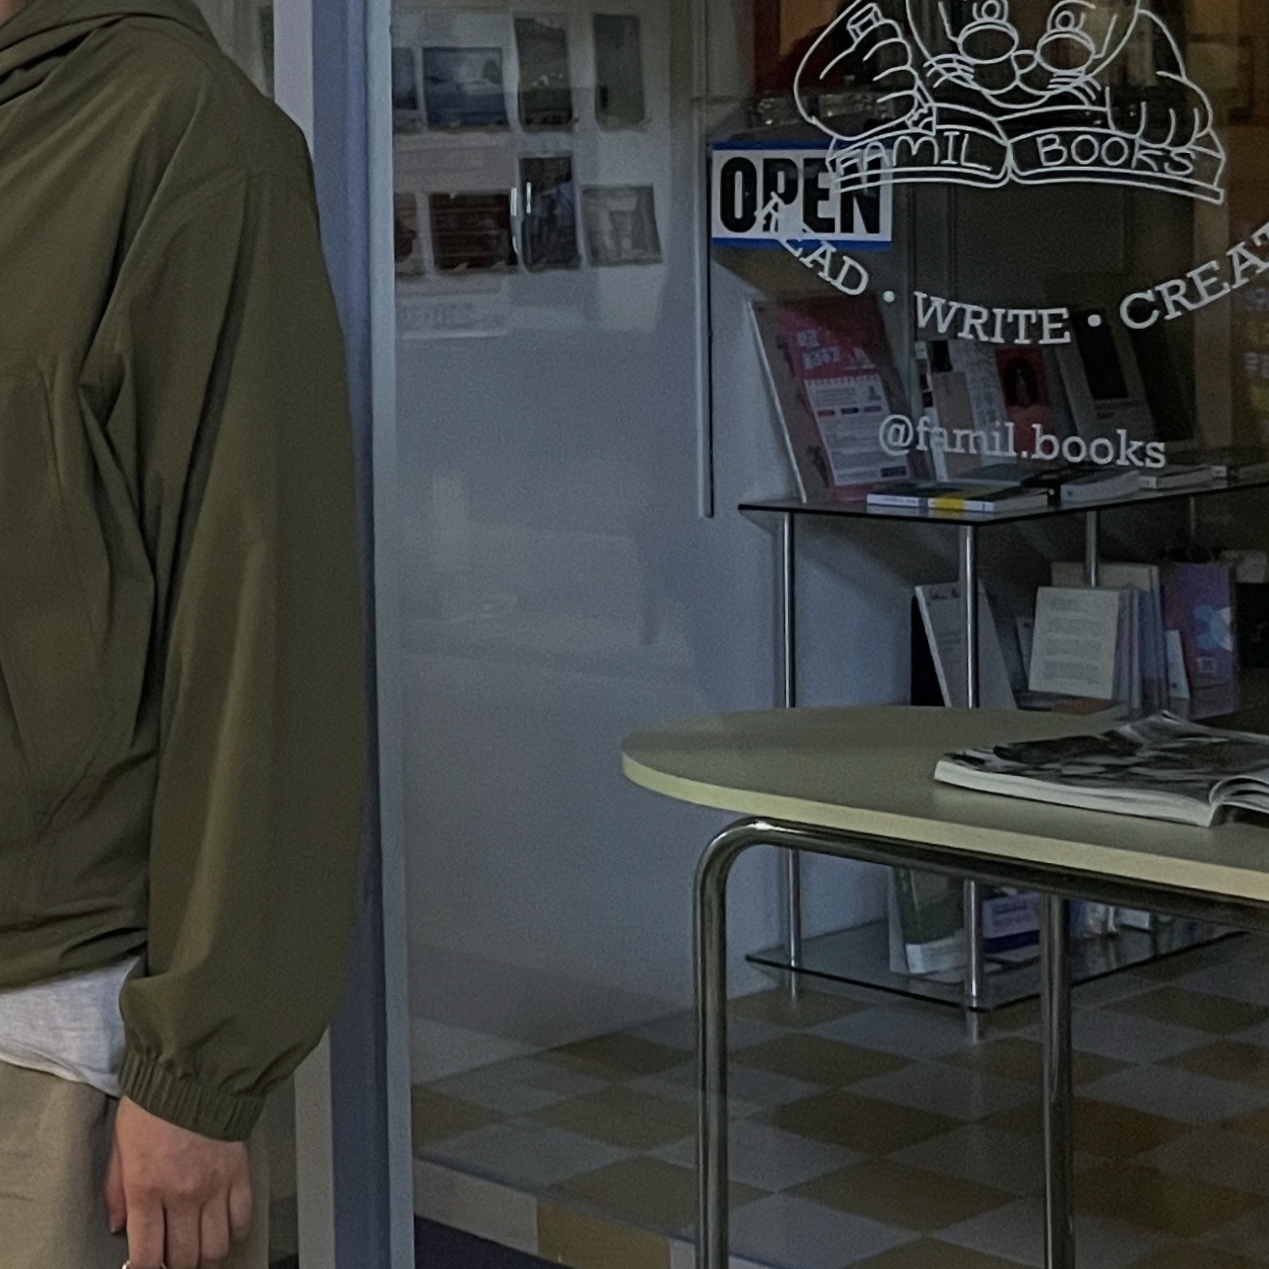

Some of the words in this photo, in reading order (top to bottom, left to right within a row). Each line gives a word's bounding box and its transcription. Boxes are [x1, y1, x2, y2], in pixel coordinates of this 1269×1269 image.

[835, 131, 992, 175] FAMIL
[1037, 133, 1195, 175] BOOKS
[720, 156, 882, 233] OPEN
[914, 291, 1071, 344] WRITE
[878, 414, 1166, 468] @famil.books
